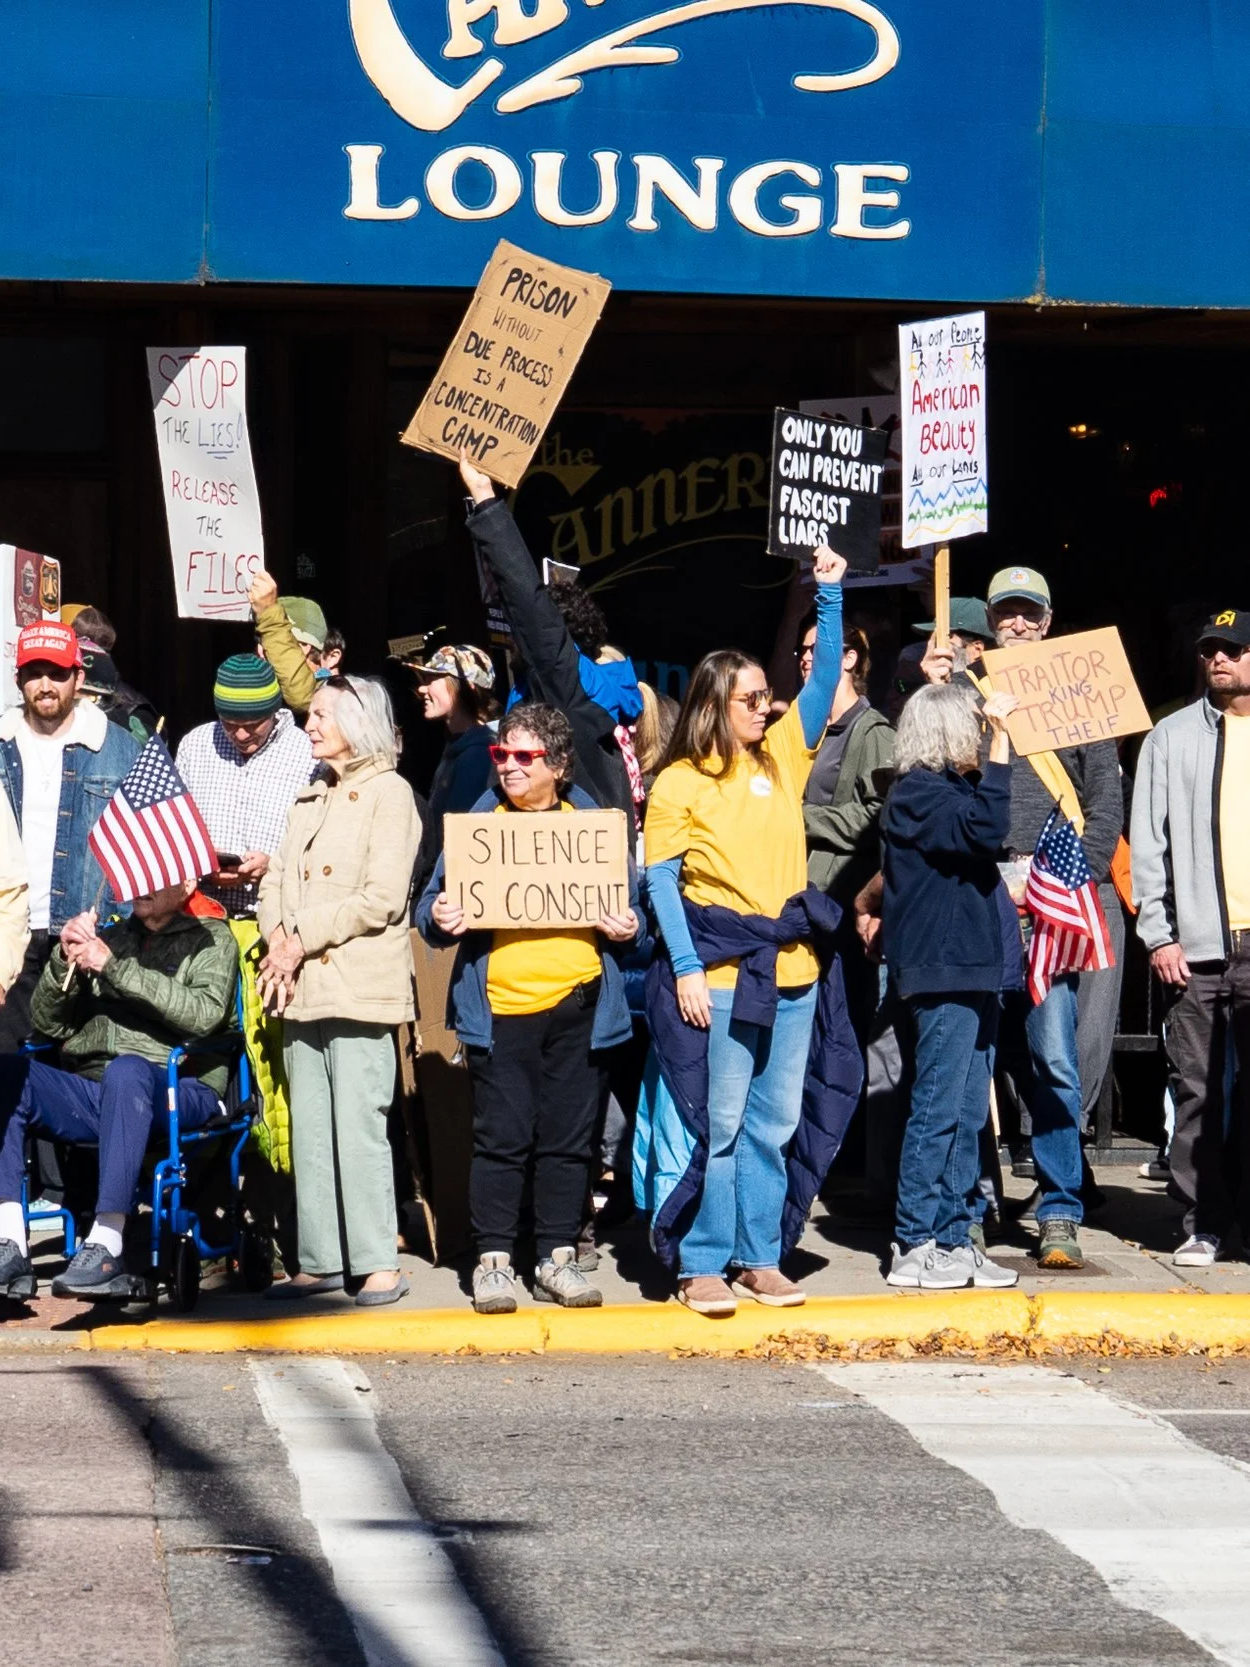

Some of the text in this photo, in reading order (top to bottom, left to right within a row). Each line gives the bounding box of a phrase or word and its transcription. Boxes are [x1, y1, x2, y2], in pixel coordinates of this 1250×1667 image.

[342, 142, 912, 241] LOUNGE
[499, 267, 578, 319] PRISON
[491, 305, 544, 343] WITHOUT
[463, 330, 554, 388] DUE PROCESS
[158, 353, 238, 410] STOP
[496, 377, 507, 393] A
[912, 379, 981, 416] American
[162, 416, 191, 445] THE
[433, 381, 542, 447] CONCENTRATION
[441, 416, 499, 462] CAMP
[781, 416, 827, 449] ONLY
[830, 425, 863, 457] YOU
[920, 419, 976, 455] Beauty
[171, 470, 239, 506] RELEASE
[778, 449, 883, 494] CAN PREVENT
[780, 485, 851, 525] FASCIST
[196, 515, 223, 539] THE
[778, 516, 829, 547] LIARS
[995, 650, 1111, 698] TRAITOR
[1048, 679, 1093, 705] KING
[1019, 683, 1127, 733] TRUMP
[1046, 715, 1119, 746] THEIF
[468, 827, 609, 865] SILENCE
[459, 880, 625, 922] IS CONSENT
